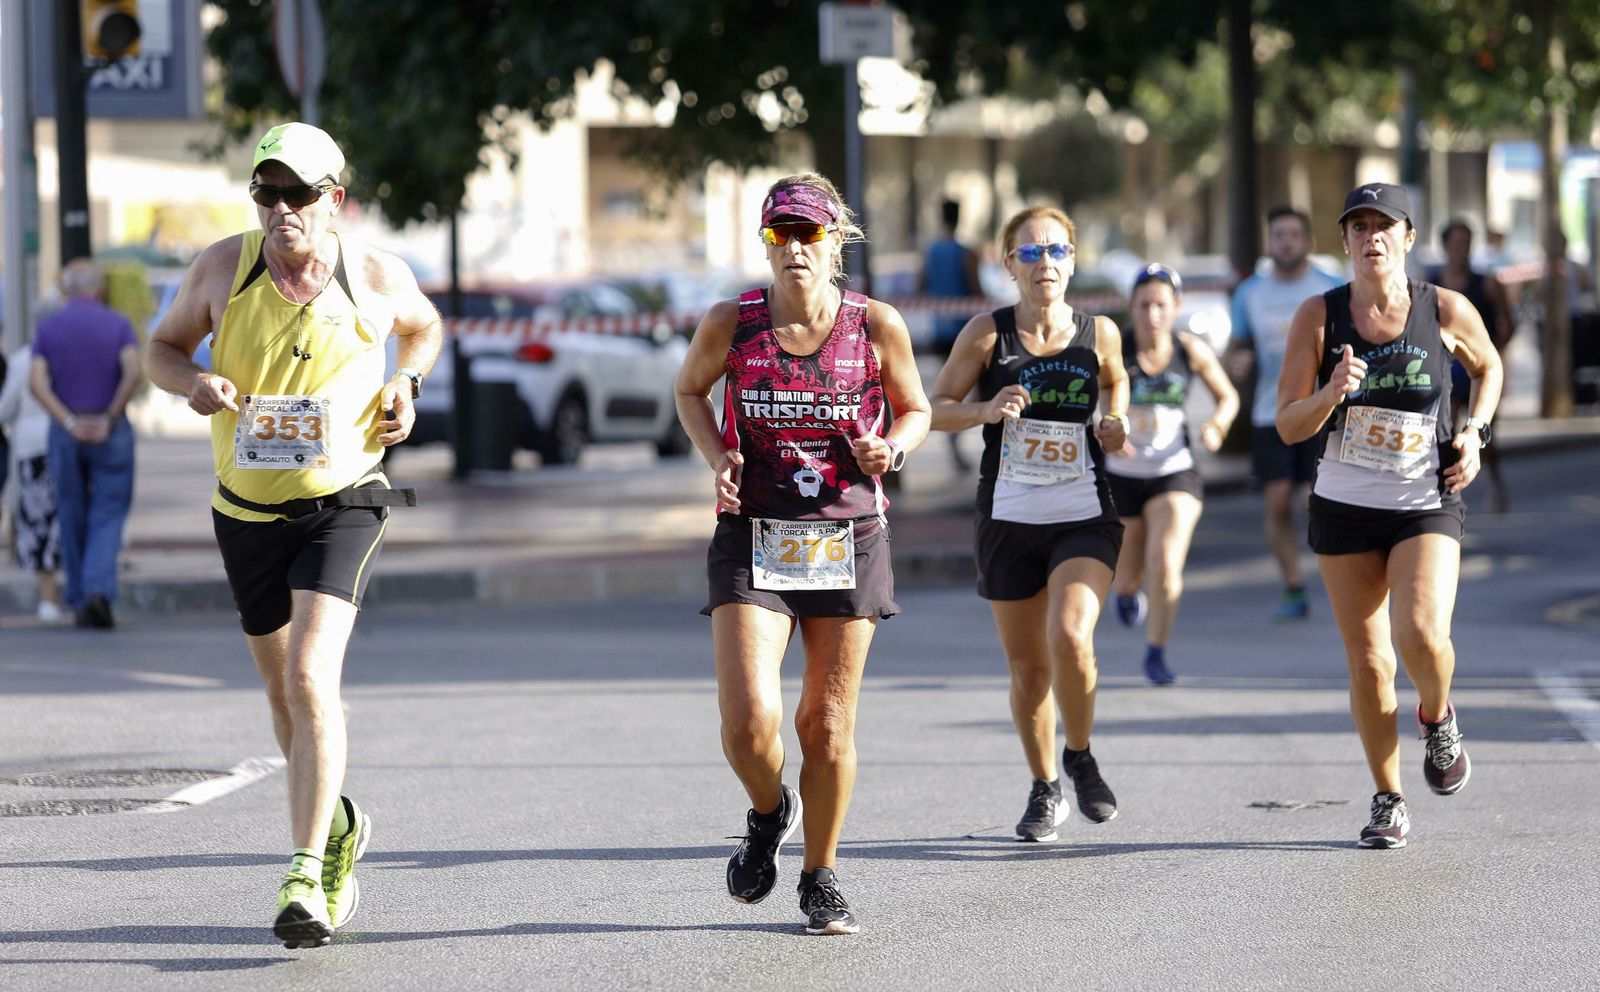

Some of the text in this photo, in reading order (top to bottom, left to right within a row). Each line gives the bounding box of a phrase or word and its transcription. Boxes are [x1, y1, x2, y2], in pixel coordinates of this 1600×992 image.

[1361, 340, 1428, 361] Atletismo
[1023, 360, 1091, 379] Atletismo
[742, 389, 814, 402] CLUB DE TRIATLON
[742, 402, 861, 420] TRISPORT
[255, 415, 322, 440] 353
[767, 421, 837, 430] MALAGA
[801, 440, 830, 448] dental
[1366, 424, 1423, 452] 532
[781, 450, 791, 458] El
[1024, 438, 1078, 463] 759
[779, 538, 846, 563] 276
